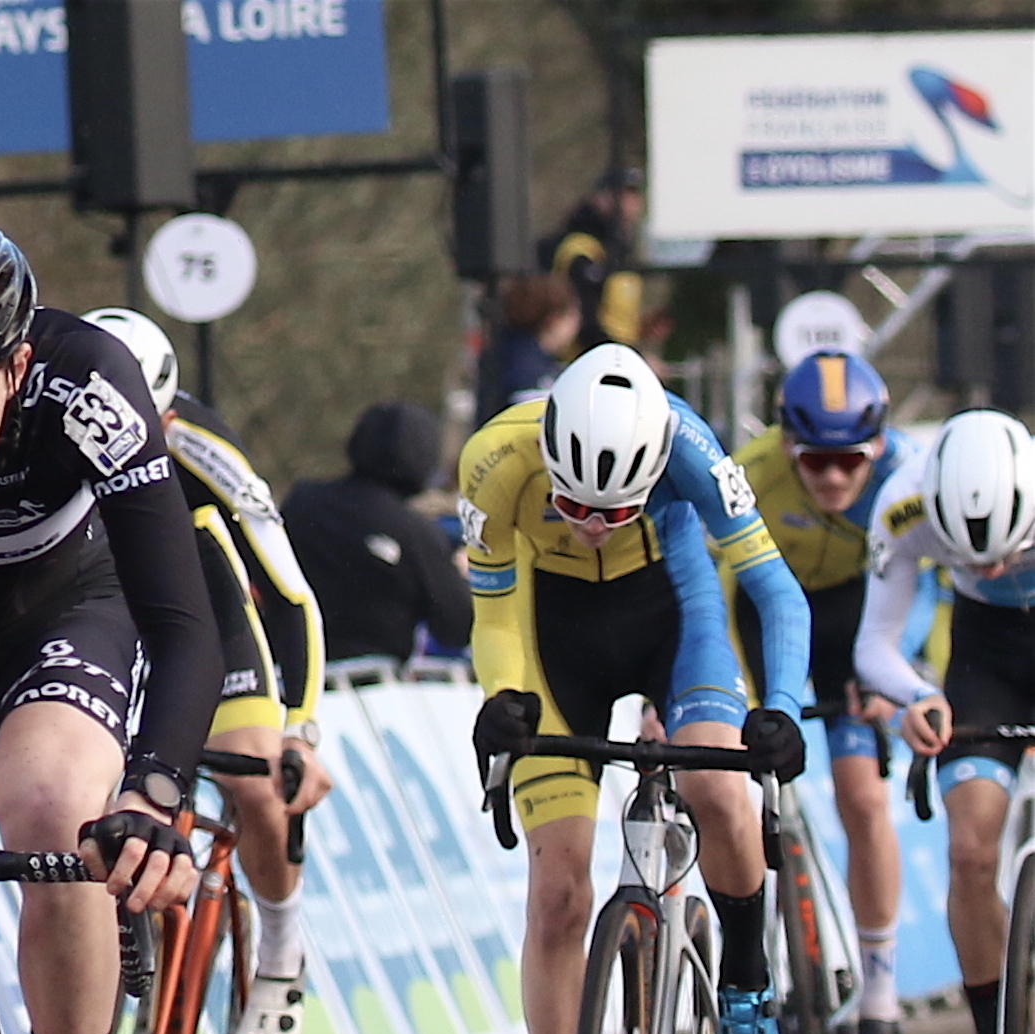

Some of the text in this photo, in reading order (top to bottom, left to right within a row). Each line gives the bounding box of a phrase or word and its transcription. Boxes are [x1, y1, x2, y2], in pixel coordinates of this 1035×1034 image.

[218, 0, 348, 42] LOIRE
[70, 392, 124, 445] 53
[678, 424, 711, 453] PAYS
[94, 455, 171, 500] NORET
[14, 682, 122, 729] NORET
